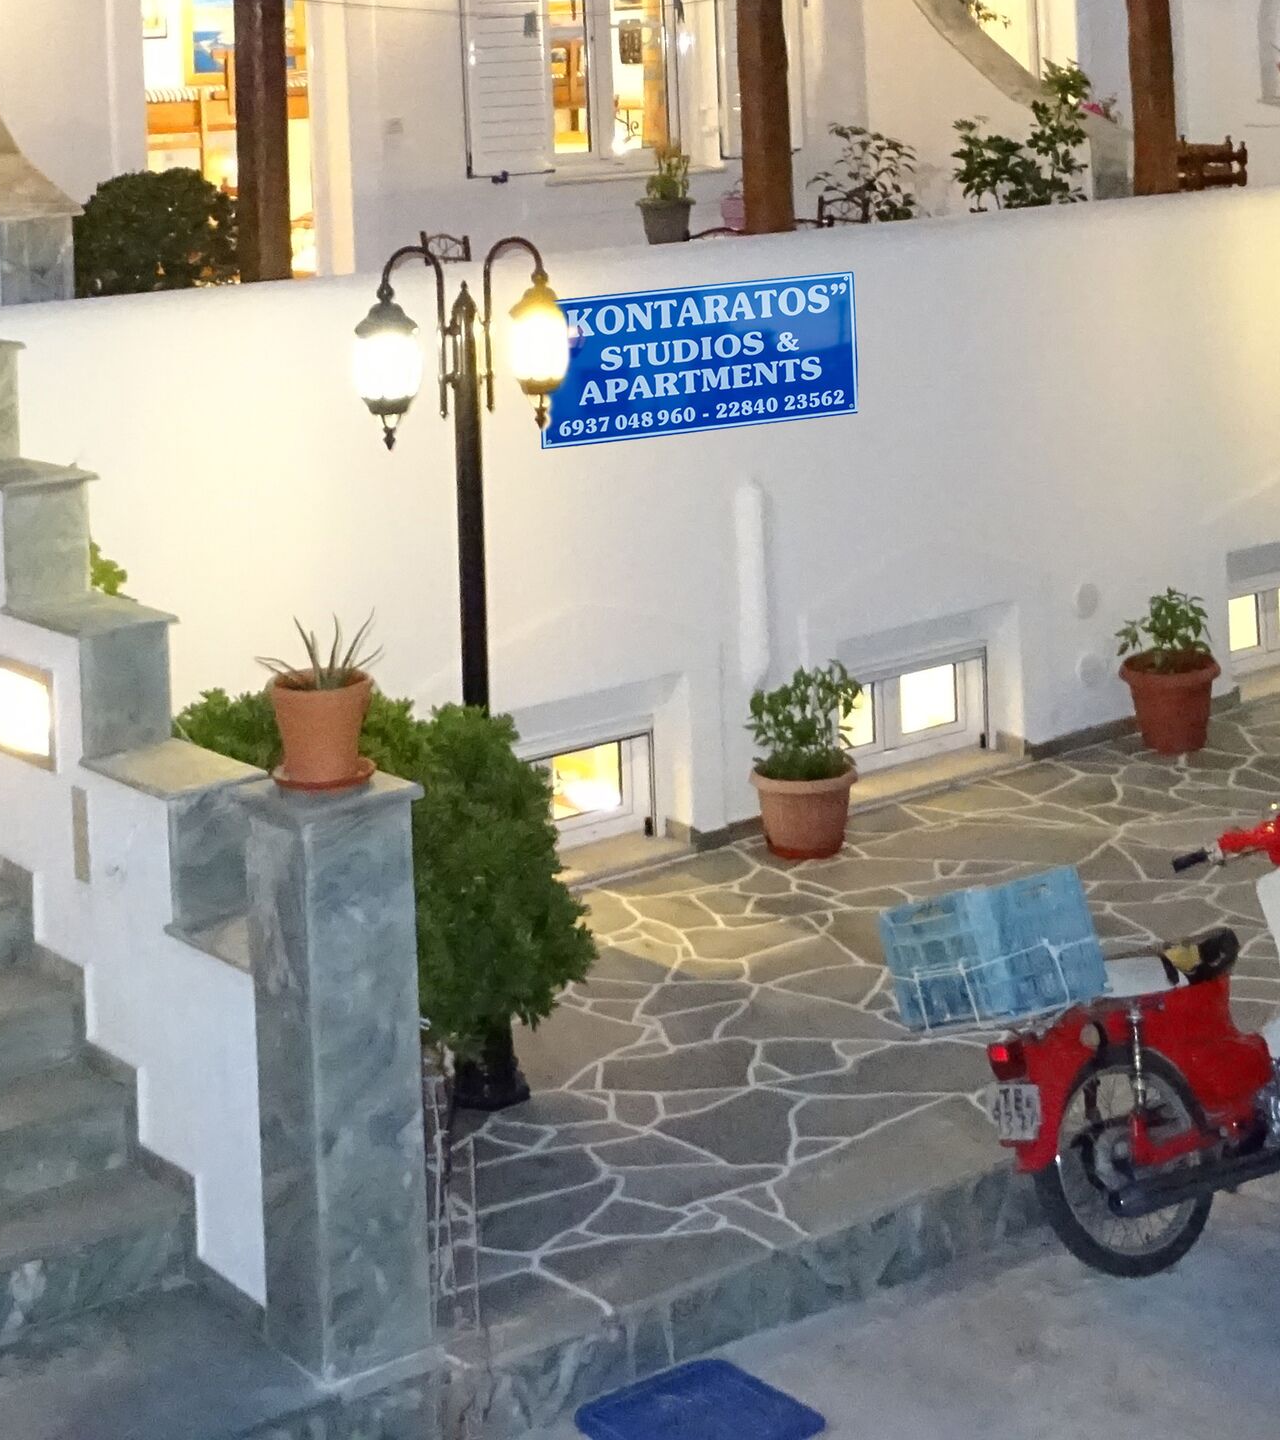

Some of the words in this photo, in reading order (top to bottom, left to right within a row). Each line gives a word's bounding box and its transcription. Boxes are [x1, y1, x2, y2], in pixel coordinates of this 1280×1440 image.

[600, 331, 764, 372] STUDIOS
[776, 331, 800, 353] &
[578, 356, 822, 406] APARTMENTS
[558, 416, 610, 437] 6937
[615, 411, 654, 430] 048
[657, 406, 696, 427] 960
[716, 397, 778, 419] 22840
[784, 389, 846, 411] 23562
